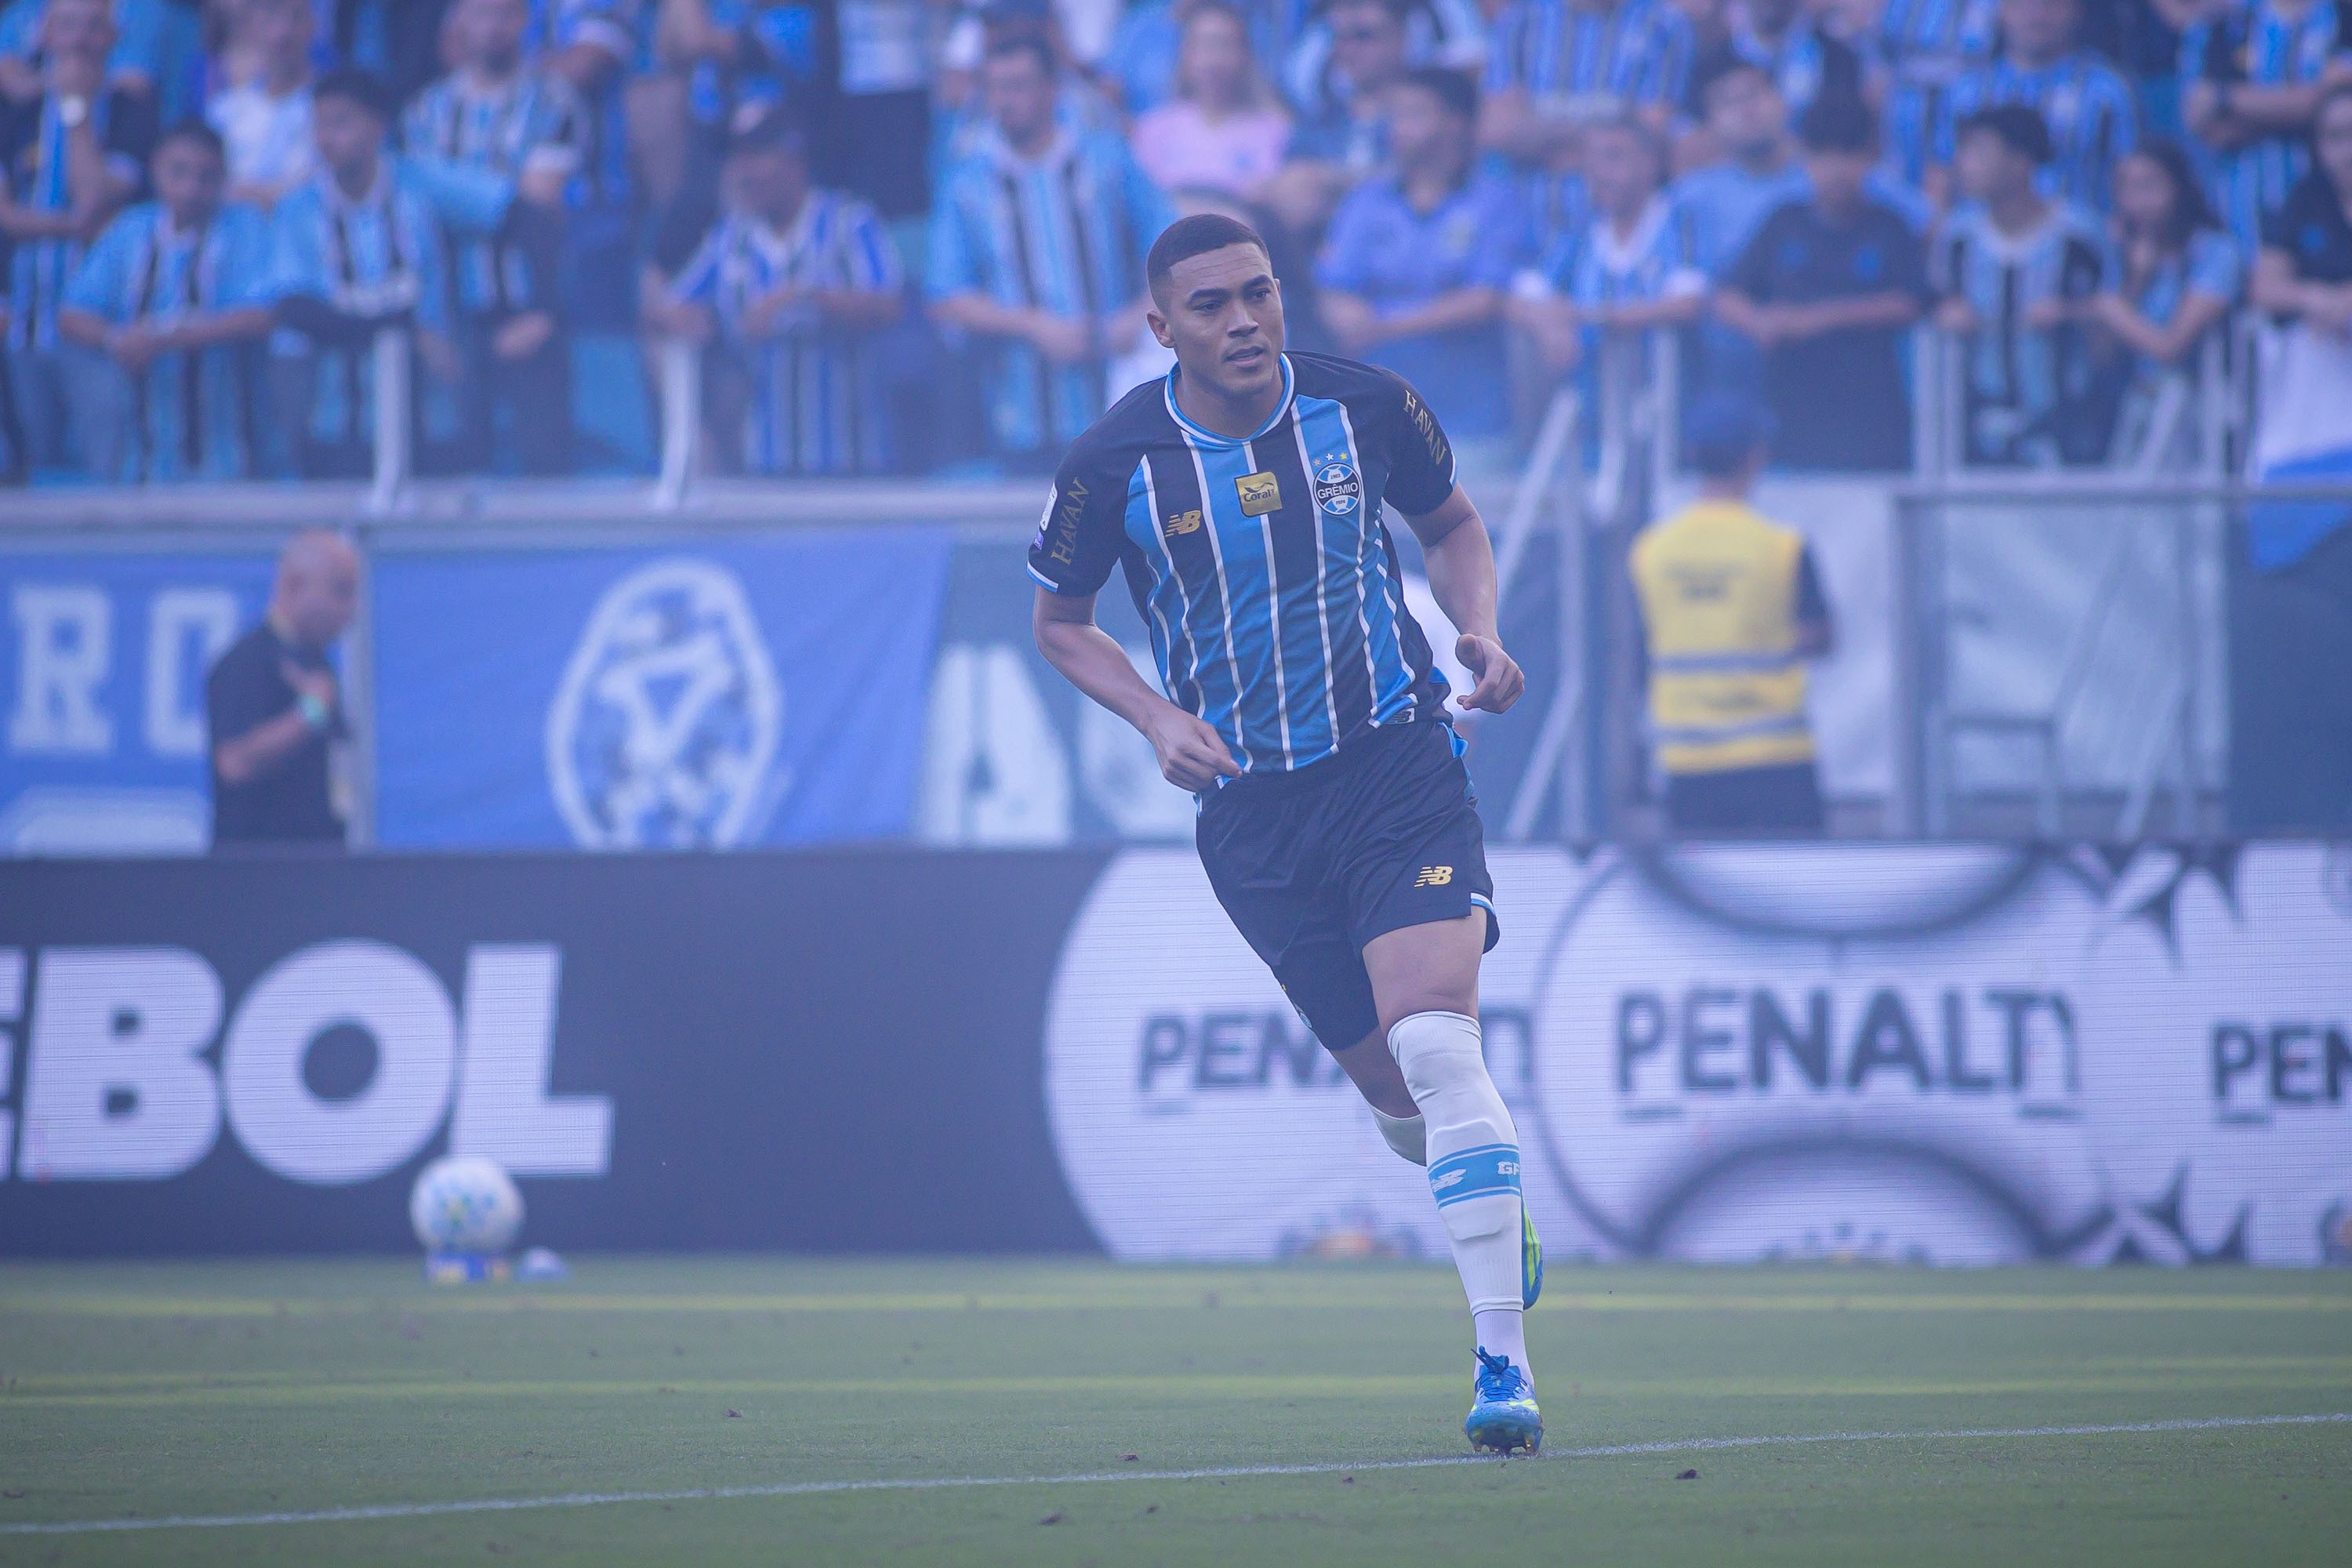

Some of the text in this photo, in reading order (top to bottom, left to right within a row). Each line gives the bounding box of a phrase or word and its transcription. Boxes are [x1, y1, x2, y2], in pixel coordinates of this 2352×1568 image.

[1403, 390, 1447, 465] HAVAN
[1051, 477, 1090, 564] HAVAN
[1243, 488, 1272, 503] Coral
[1317, 482, 1359, 499] GRÊMIO
[0, 938, 615, 1185] BOL
